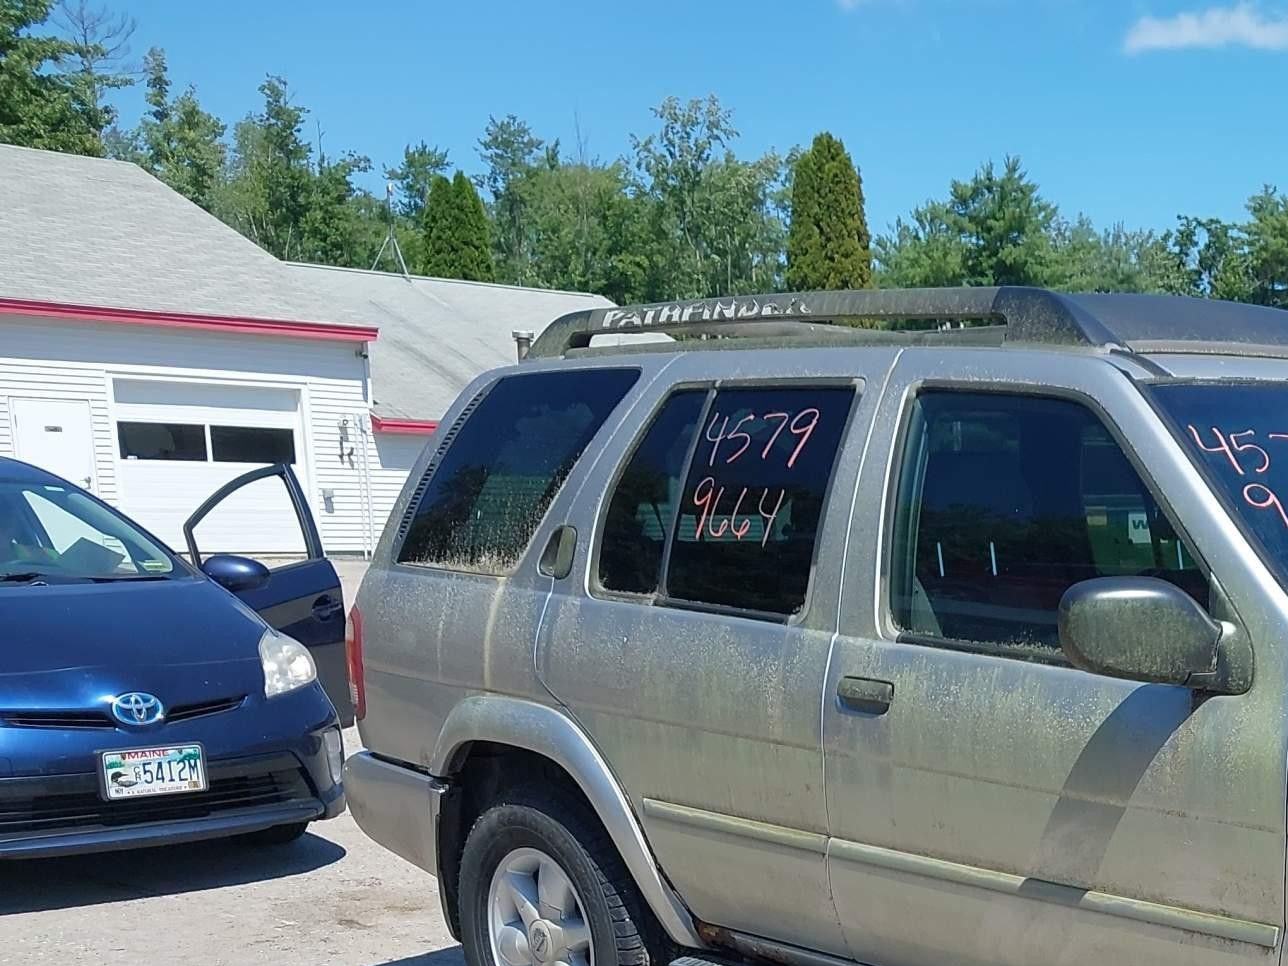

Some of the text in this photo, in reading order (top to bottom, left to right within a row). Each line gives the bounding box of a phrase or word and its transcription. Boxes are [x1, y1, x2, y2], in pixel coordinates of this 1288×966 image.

[706, 408, 820, 467] 4579
[694, 477, 785, 548] 9664
[127, 750, 169, 760] MAINE
